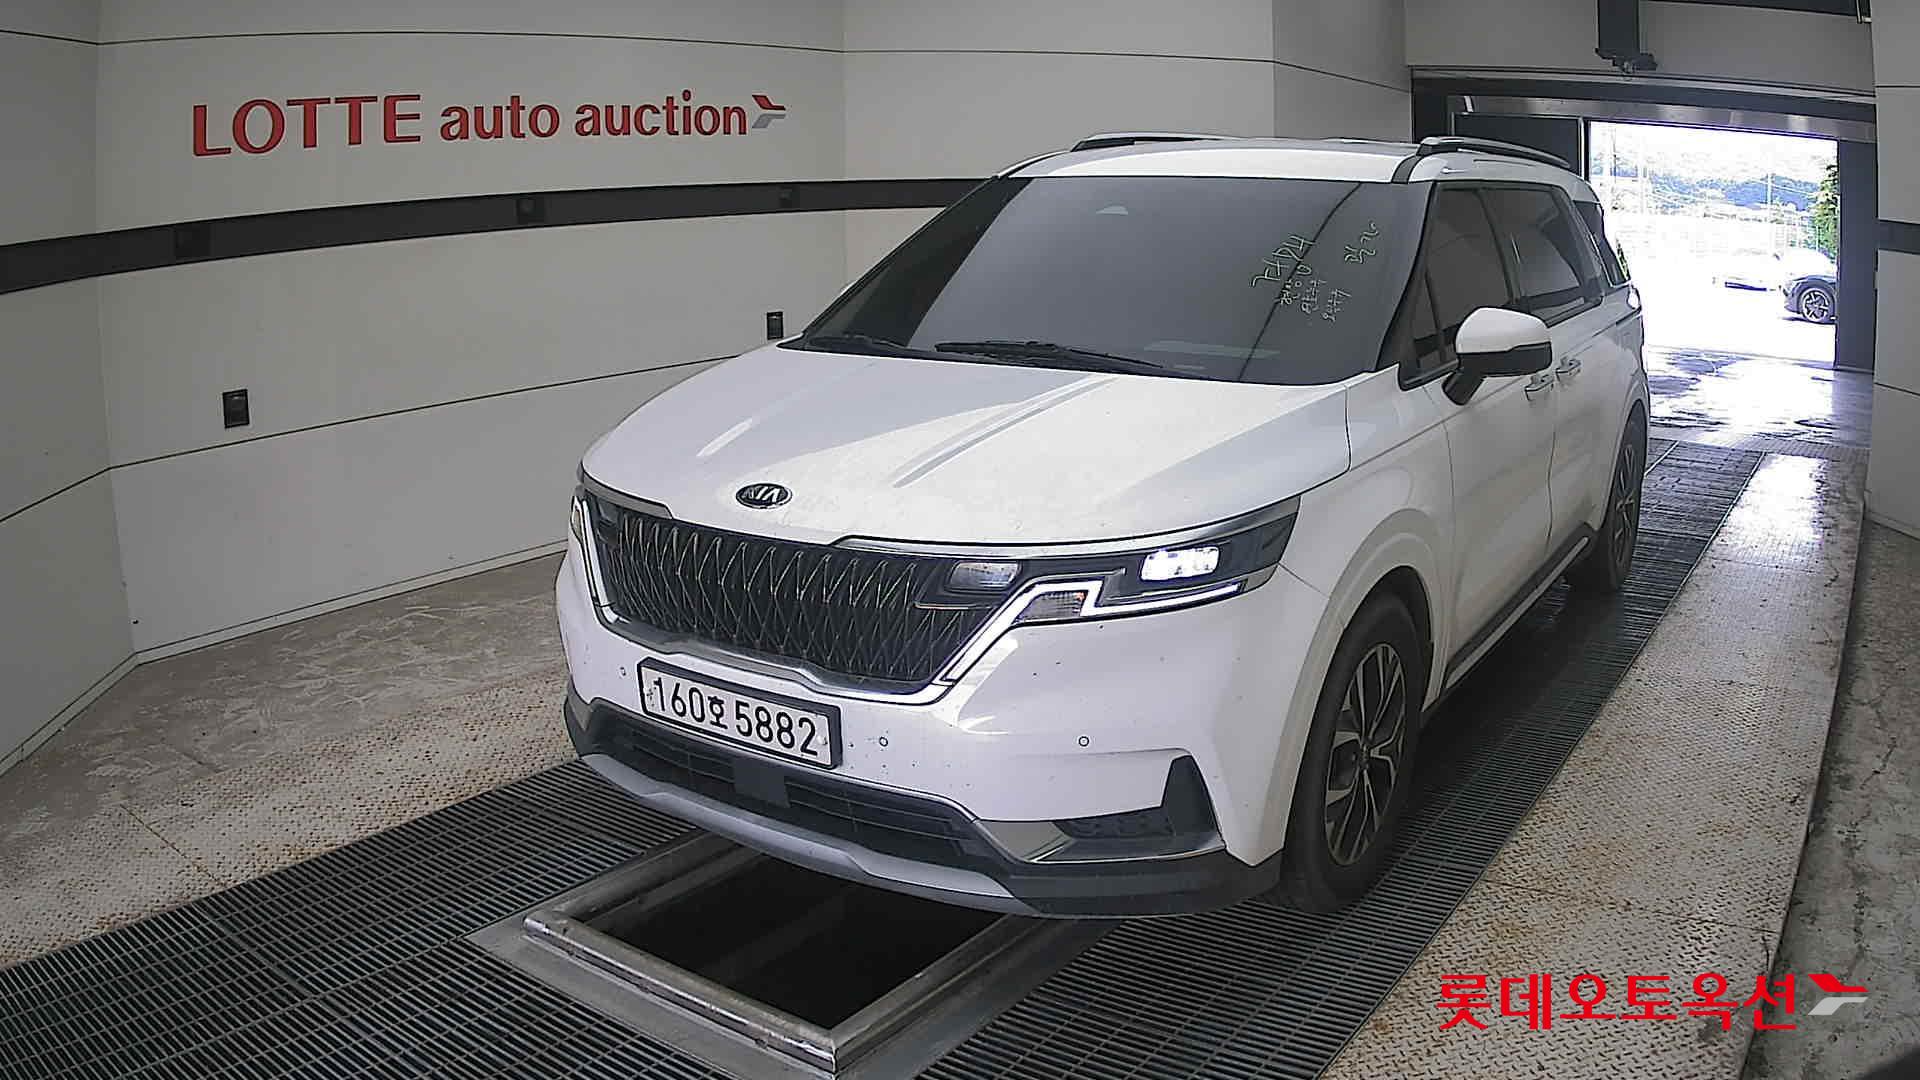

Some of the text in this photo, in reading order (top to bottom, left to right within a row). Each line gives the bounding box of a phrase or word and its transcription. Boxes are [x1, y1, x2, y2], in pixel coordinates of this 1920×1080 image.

[193, 91, 747, 156] LOTTE auto auction
[734, 700, 818, 756] 5882
